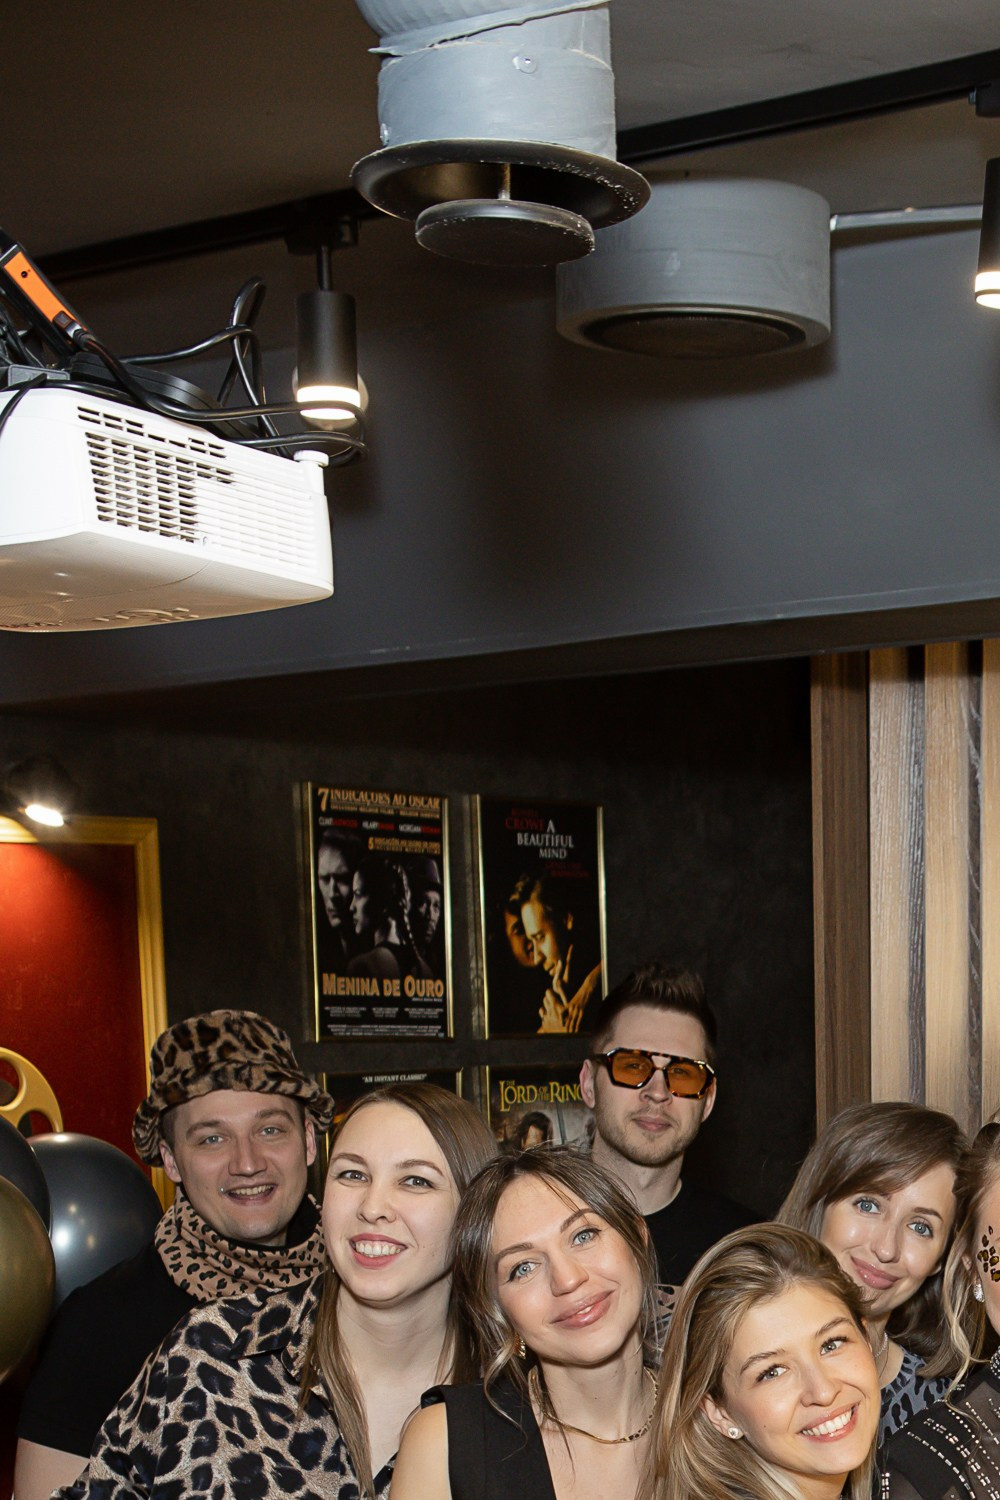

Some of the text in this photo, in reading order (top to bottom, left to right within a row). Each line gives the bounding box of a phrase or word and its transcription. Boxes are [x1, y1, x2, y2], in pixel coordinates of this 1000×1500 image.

[317, 787, 329, 812] 7
[547, 819, 556, 833] A
[517, 832, 574, 848] BEAUTIFUL
[539, 848, 567, 859] MIND
[322, 973, 444, 998] MENINA DE OURO
[499, 1080, 537, 1112] LORD
